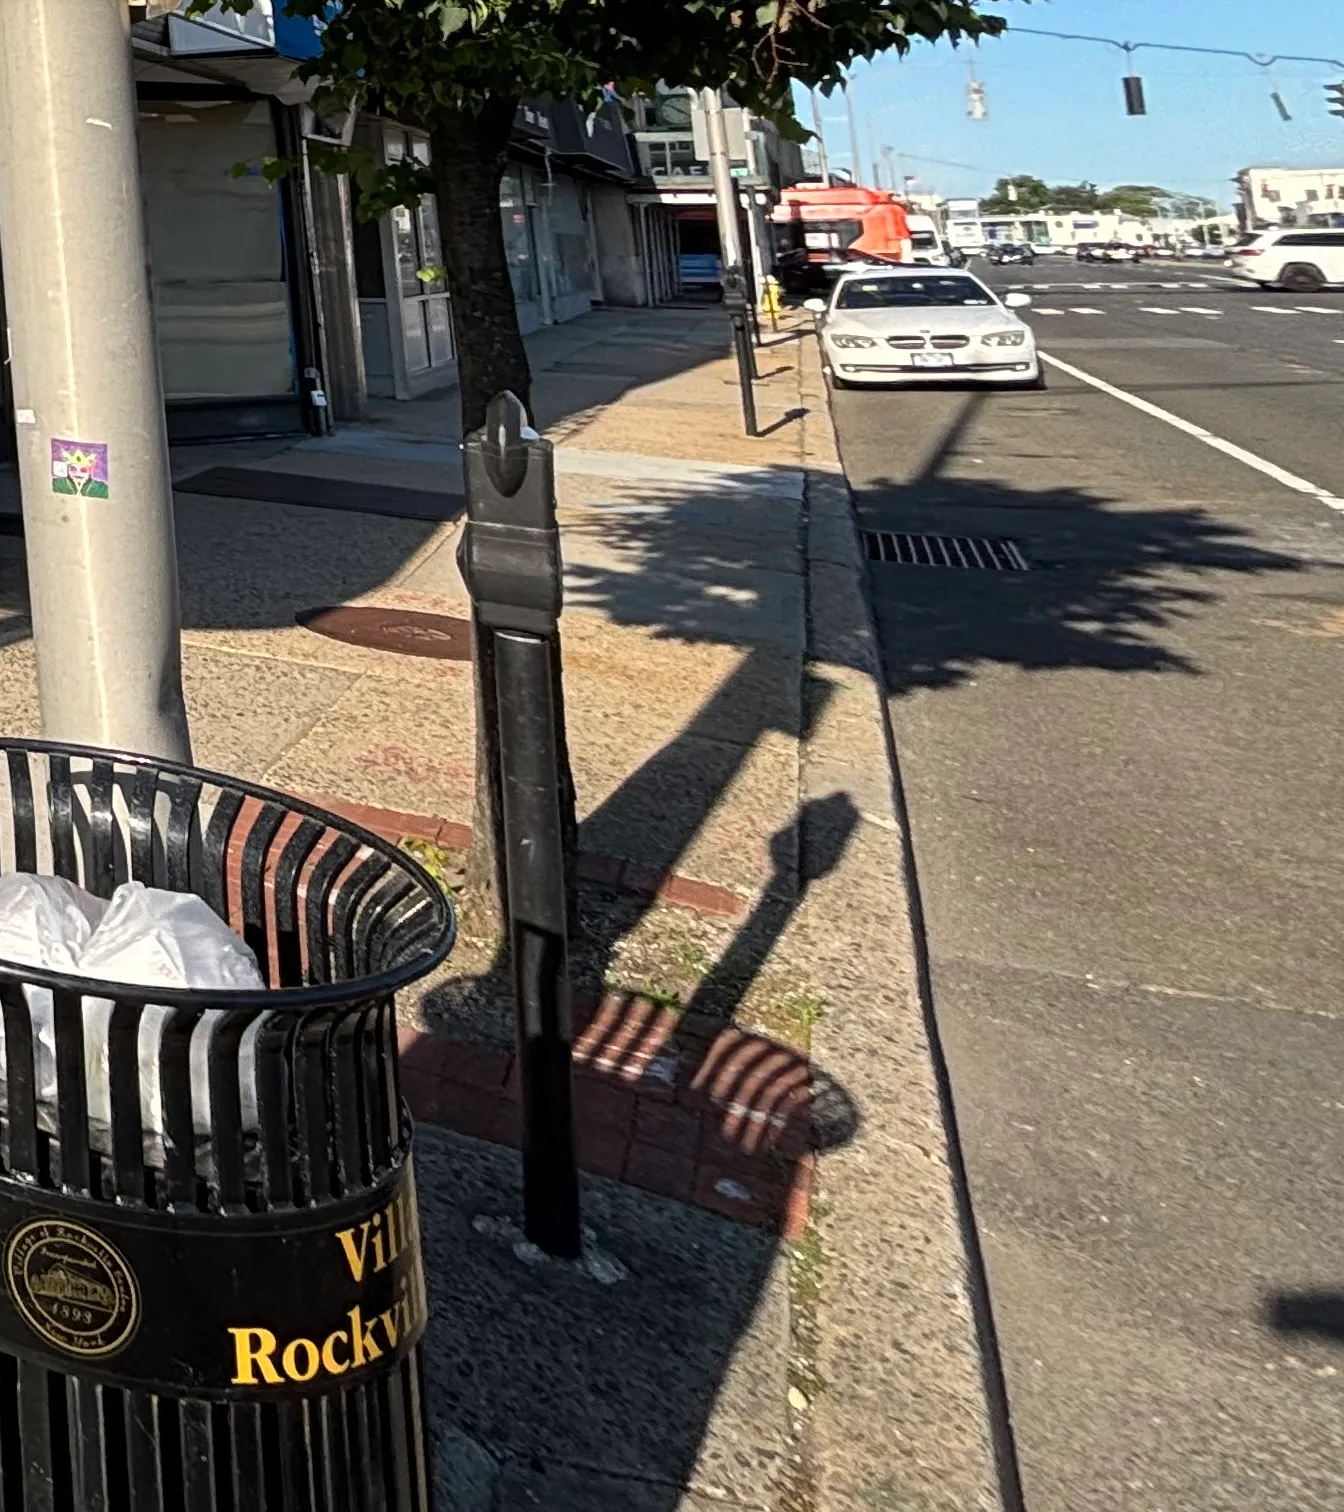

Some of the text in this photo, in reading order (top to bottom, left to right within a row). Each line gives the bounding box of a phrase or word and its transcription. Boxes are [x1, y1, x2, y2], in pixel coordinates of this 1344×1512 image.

[652, 166, 704, 176] CAF
[334, 1191, 409, 1283] Vill
[52, 1302, 93, 1325] 1893
[226, 1275, 414, 1385] Rockvi
